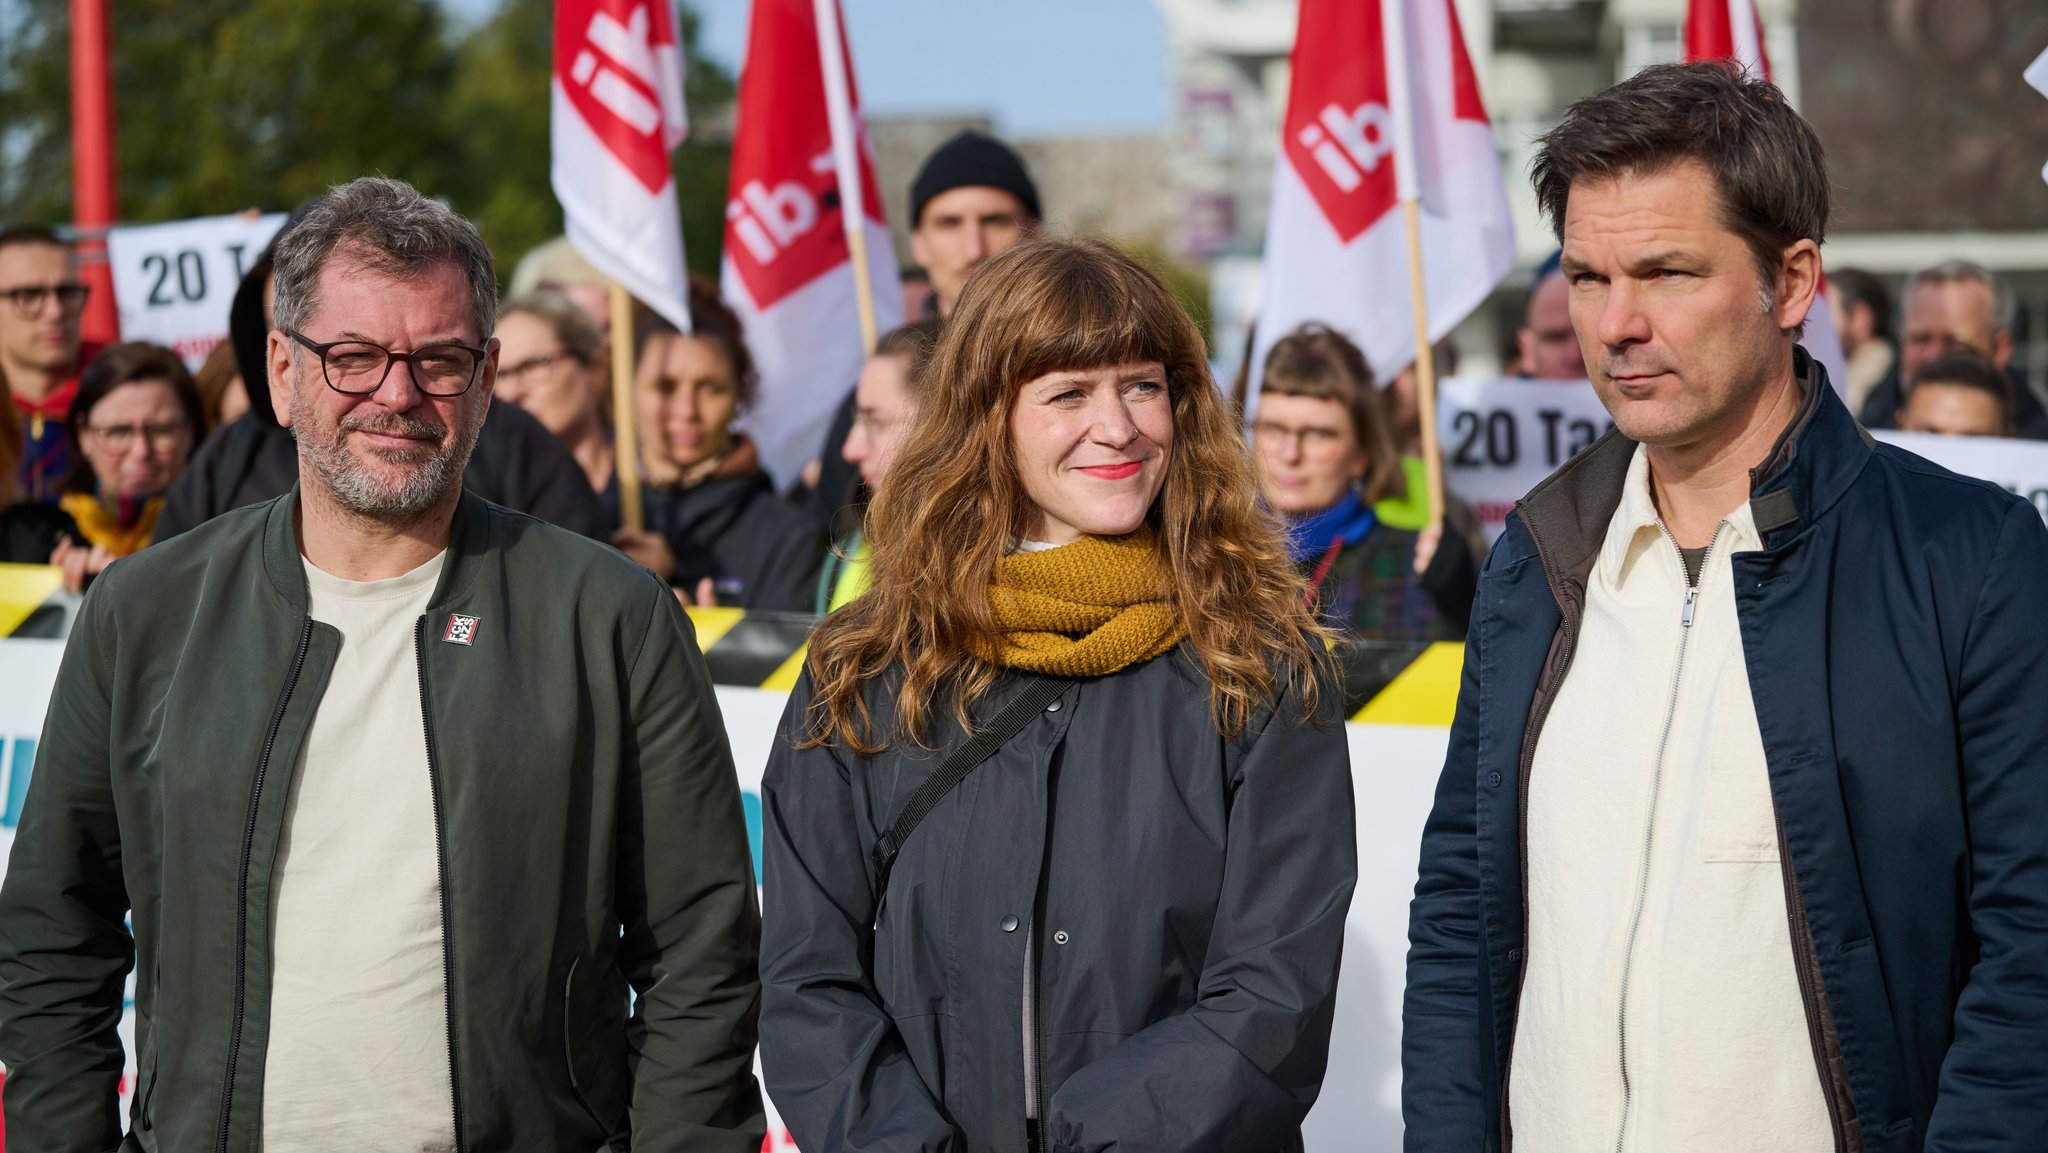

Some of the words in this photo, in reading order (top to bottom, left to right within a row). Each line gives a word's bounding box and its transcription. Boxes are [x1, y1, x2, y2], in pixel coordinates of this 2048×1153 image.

[1299, 102, 1392, 193] ib
[726, 179, 818, 266] ib
[142, 250, 207, 308] 20
[1453, 409, 1517, 469] 20
[1538, 409, 1620, 467] Ta
[448, 616, 465, 641] FCK
[457, 617, 474, 643] NZS
